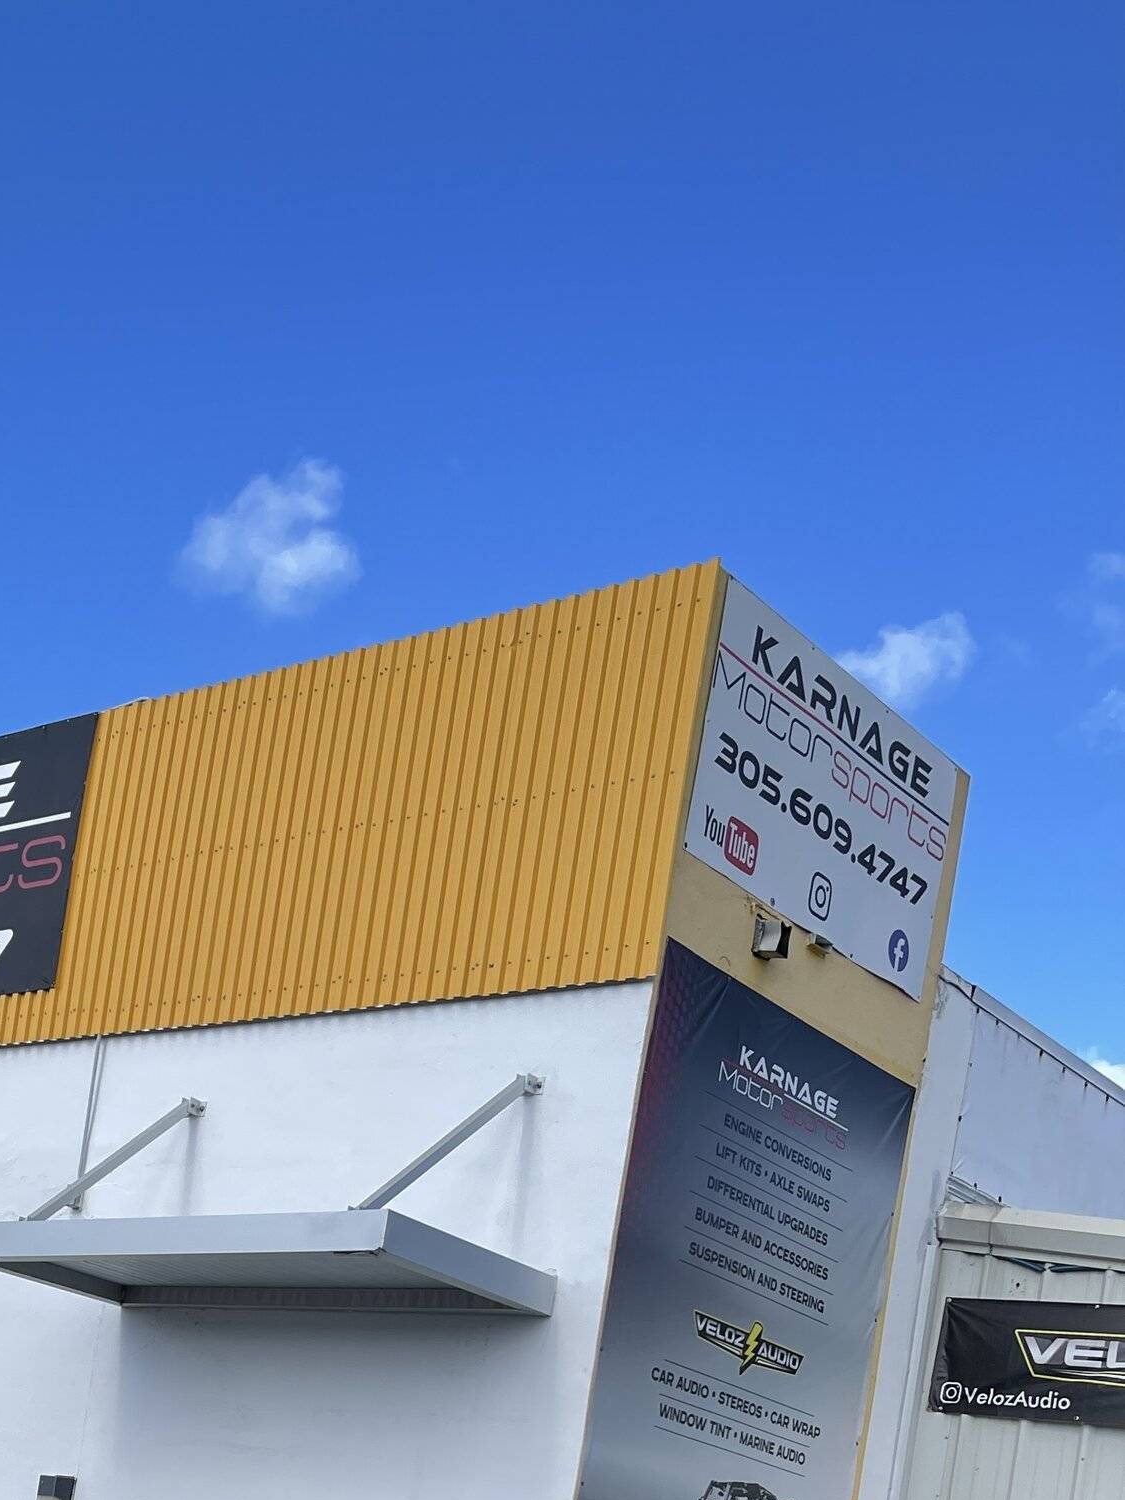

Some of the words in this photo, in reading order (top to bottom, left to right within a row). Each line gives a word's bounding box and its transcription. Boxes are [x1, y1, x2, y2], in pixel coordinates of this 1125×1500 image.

[752, 626, 933, 799] KARNAGE
[713, 651, 946, 861] Motorsports
[704, 804, 755, 869] YouTube
[715, 732, 928, 905] 305.609.4747
[739, 1045, 839, 1118] KARNAGE
[716, 1142, 738, 1165] LIFT
[739, 1154, 762, 1177] KITS
[769, 1173, 794, 1195] AXLE
[796, 1185, 830, 1212] SWAPS
[724, 1113, 762, 1144] ENGINE
[764, 1136, 832, 1182] CONVERSIONS
[695, 1207, 739, 1239] BUMPER
[741, 1229, 762, 1249] AND
[764, 1240, 829, 1280] ACCESSORIES
[707, 1176, 775, 1220] DIFFERENTIAL
[777, 1210, 828, 1246] UPGRADES
[688, 1242, 756, 1282] SUSPENSION
[757, 1273, 778, 1292] AND
[779, 1283, 825, 1313] STEERING
[696, 1317, 747, 1348] VELOZ
[758, 1342, 800, 1370] AUDIO
[651, 1367, 674, 1387] CAR
[676, 1376, 709, 1399] AUDIO
[718, 1391, 763, 1419] STEREOS
[770, 1411, 791, 1430] CAR
[791, 1418, 821, 1439] WRAP
[964, 1387, 1071, 1410] VelozAudio
[659, 1403, 708, 1431] WINDOW
[709, 1420, 732, 1440] TINT
[739, 1431, 775, 1455] MARINE
[776, 1447, 806, 1466] AUDIO
